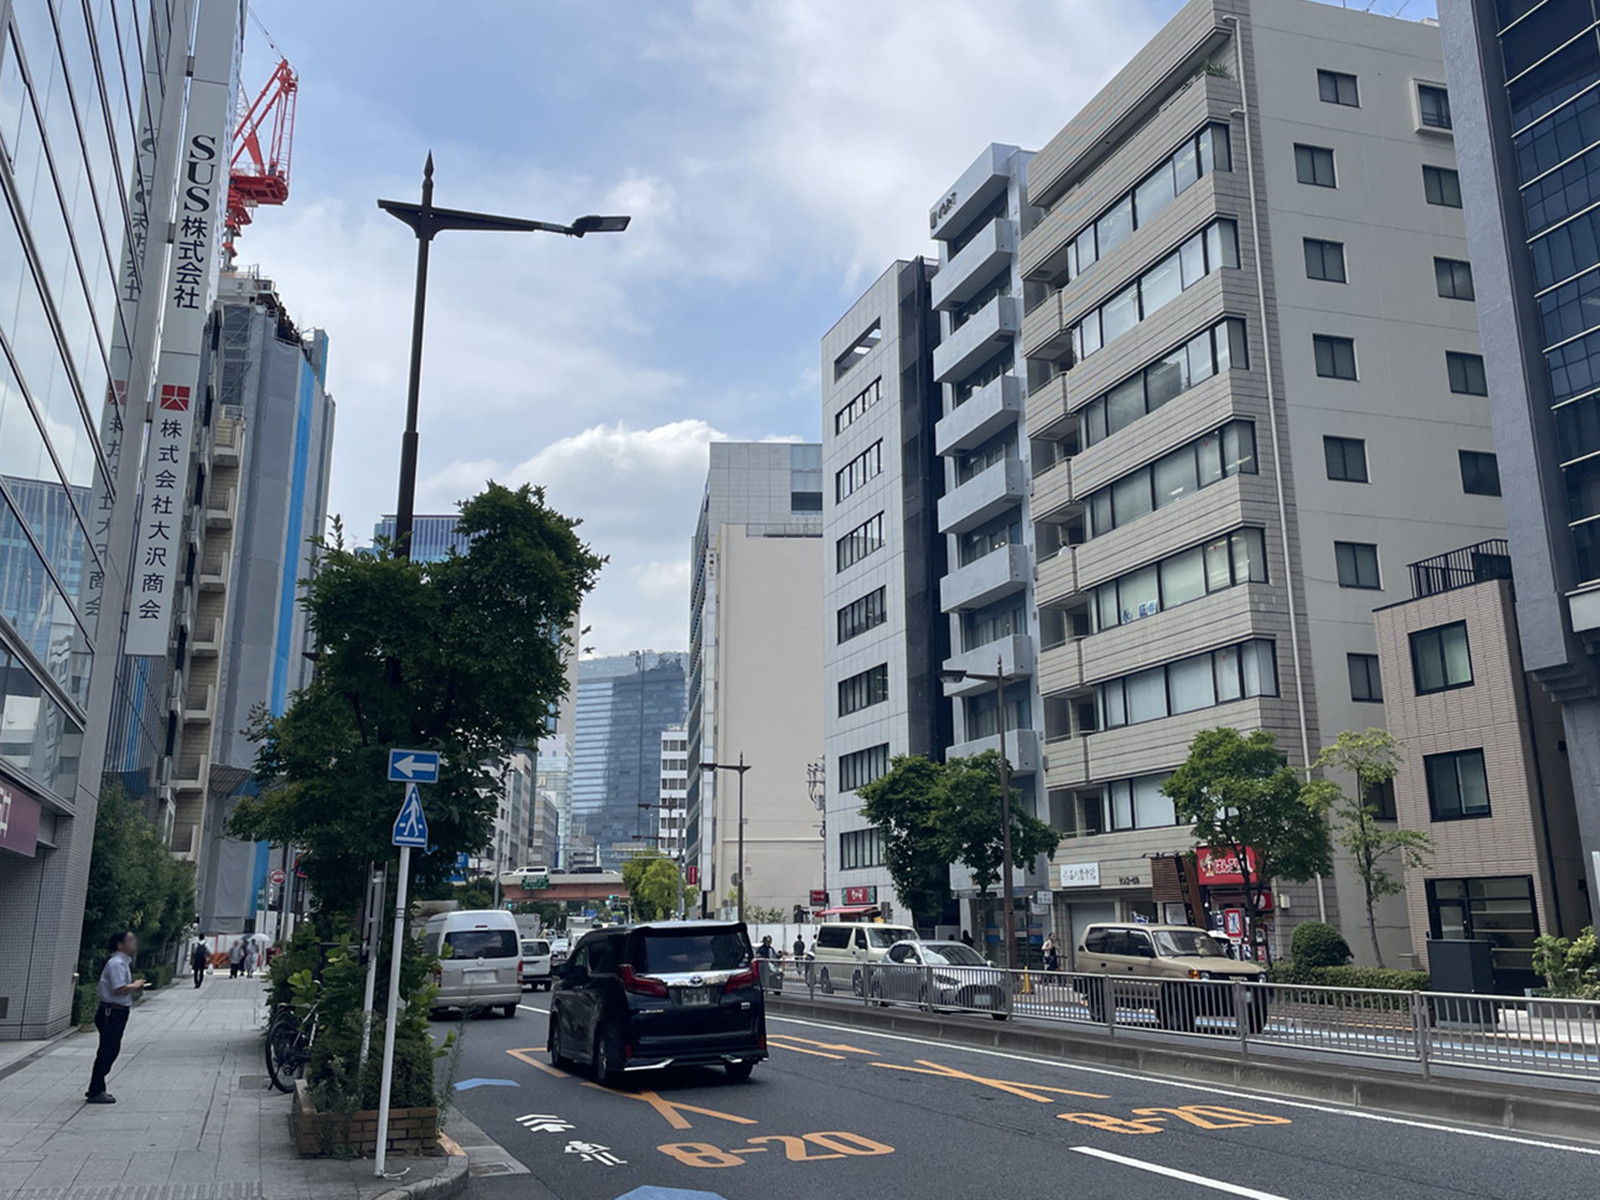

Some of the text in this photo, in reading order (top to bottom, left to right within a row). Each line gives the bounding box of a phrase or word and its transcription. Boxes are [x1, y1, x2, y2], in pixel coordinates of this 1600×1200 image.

[173, 134, 217, 310] SUS株式会社
[139, 418, 183, 620] 株式会社大沢商会
[656, 1131, 896, 1169] 8-20
